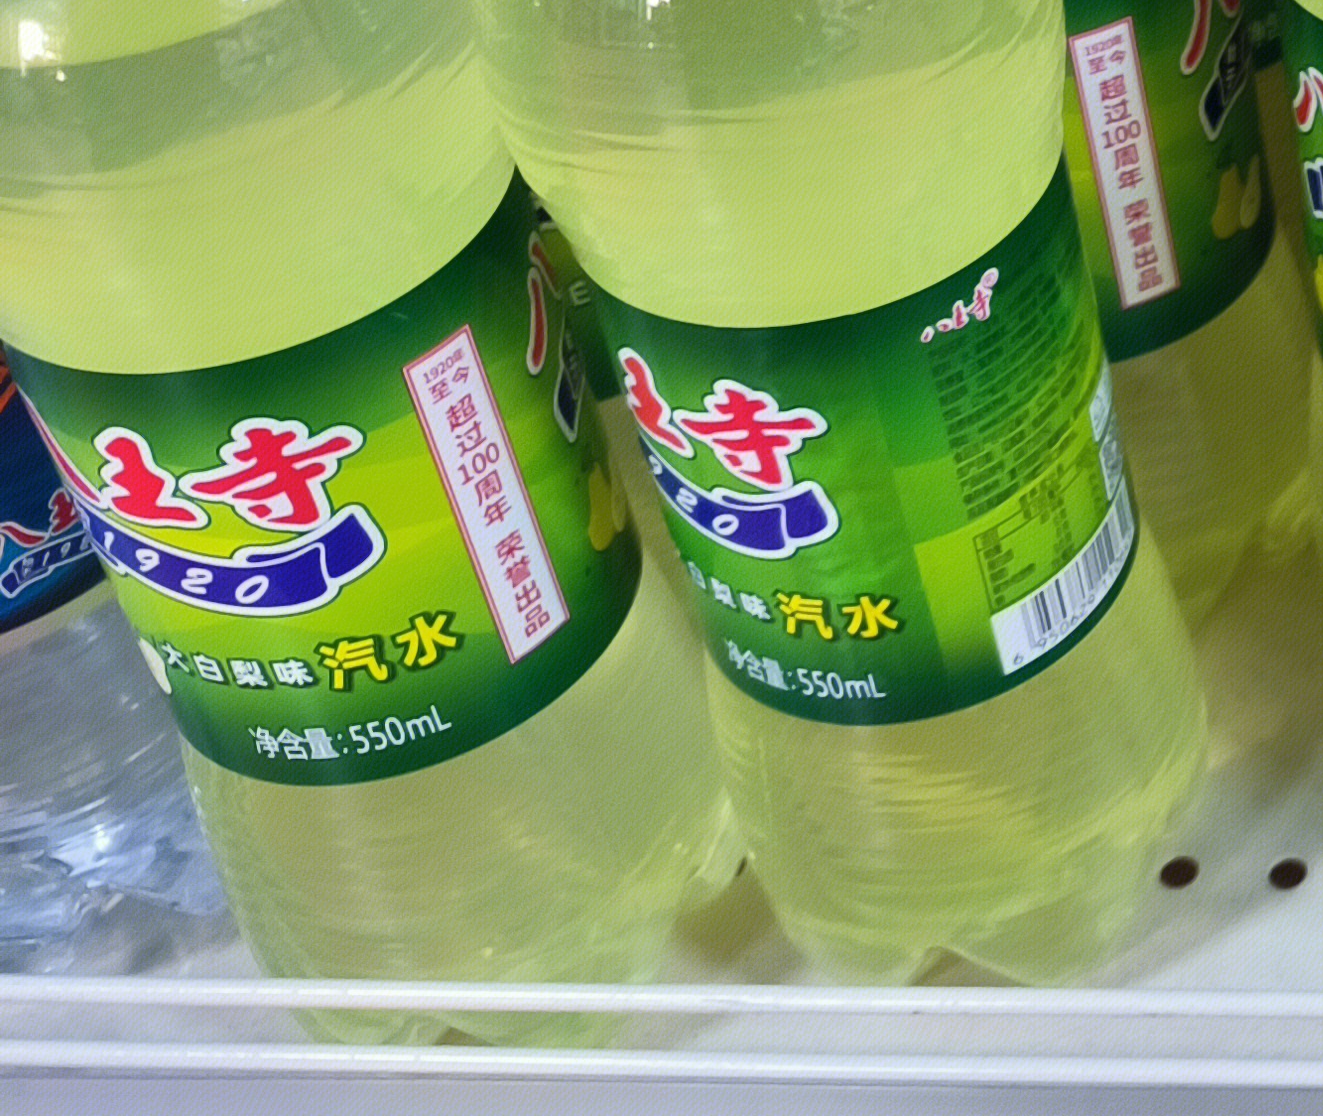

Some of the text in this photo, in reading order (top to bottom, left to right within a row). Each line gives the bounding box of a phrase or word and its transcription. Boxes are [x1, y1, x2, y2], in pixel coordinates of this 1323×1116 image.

[427, 365, 471, 406] 至今
[775, 591, 900, 641] 汽水
[316, 609, 464, 692] 汽水
[249, 704, 453, 762] 净含量:550mL
